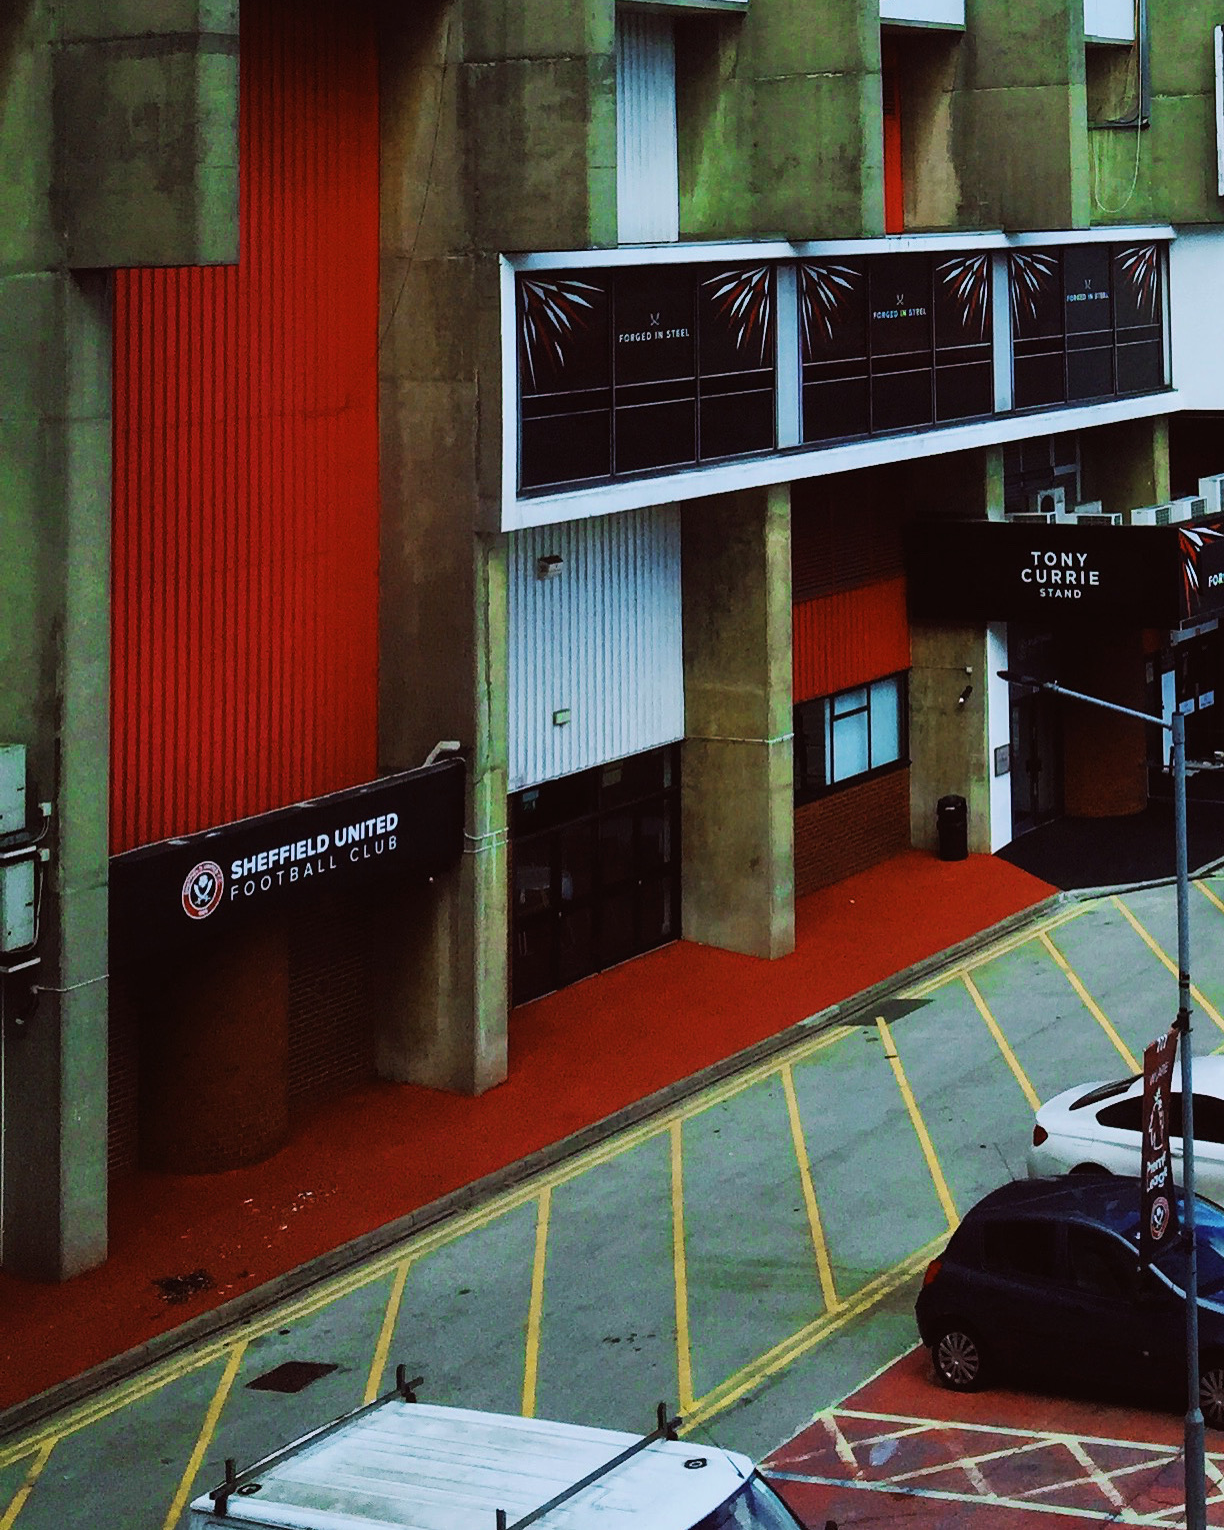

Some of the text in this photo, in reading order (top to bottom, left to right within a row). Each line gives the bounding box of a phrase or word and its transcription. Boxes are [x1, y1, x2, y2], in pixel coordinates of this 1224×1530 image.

[873, 308, 927, 320] FORGED IN STEEL
[619, 328, 690, 343] FORGED IN STEEL
[1030, 551, 1088, 568] TONY
[1021, 568, 1100, 586] CURRIE
[1039, 587, 1082, 599] STAND
[231, 834, 330, 880] SHEFFIELD
[334, 812, 399, 847] UNITED
[230, 855, 337, 901] FOOTBALL
[351, 835, 399, 862] CLUB
